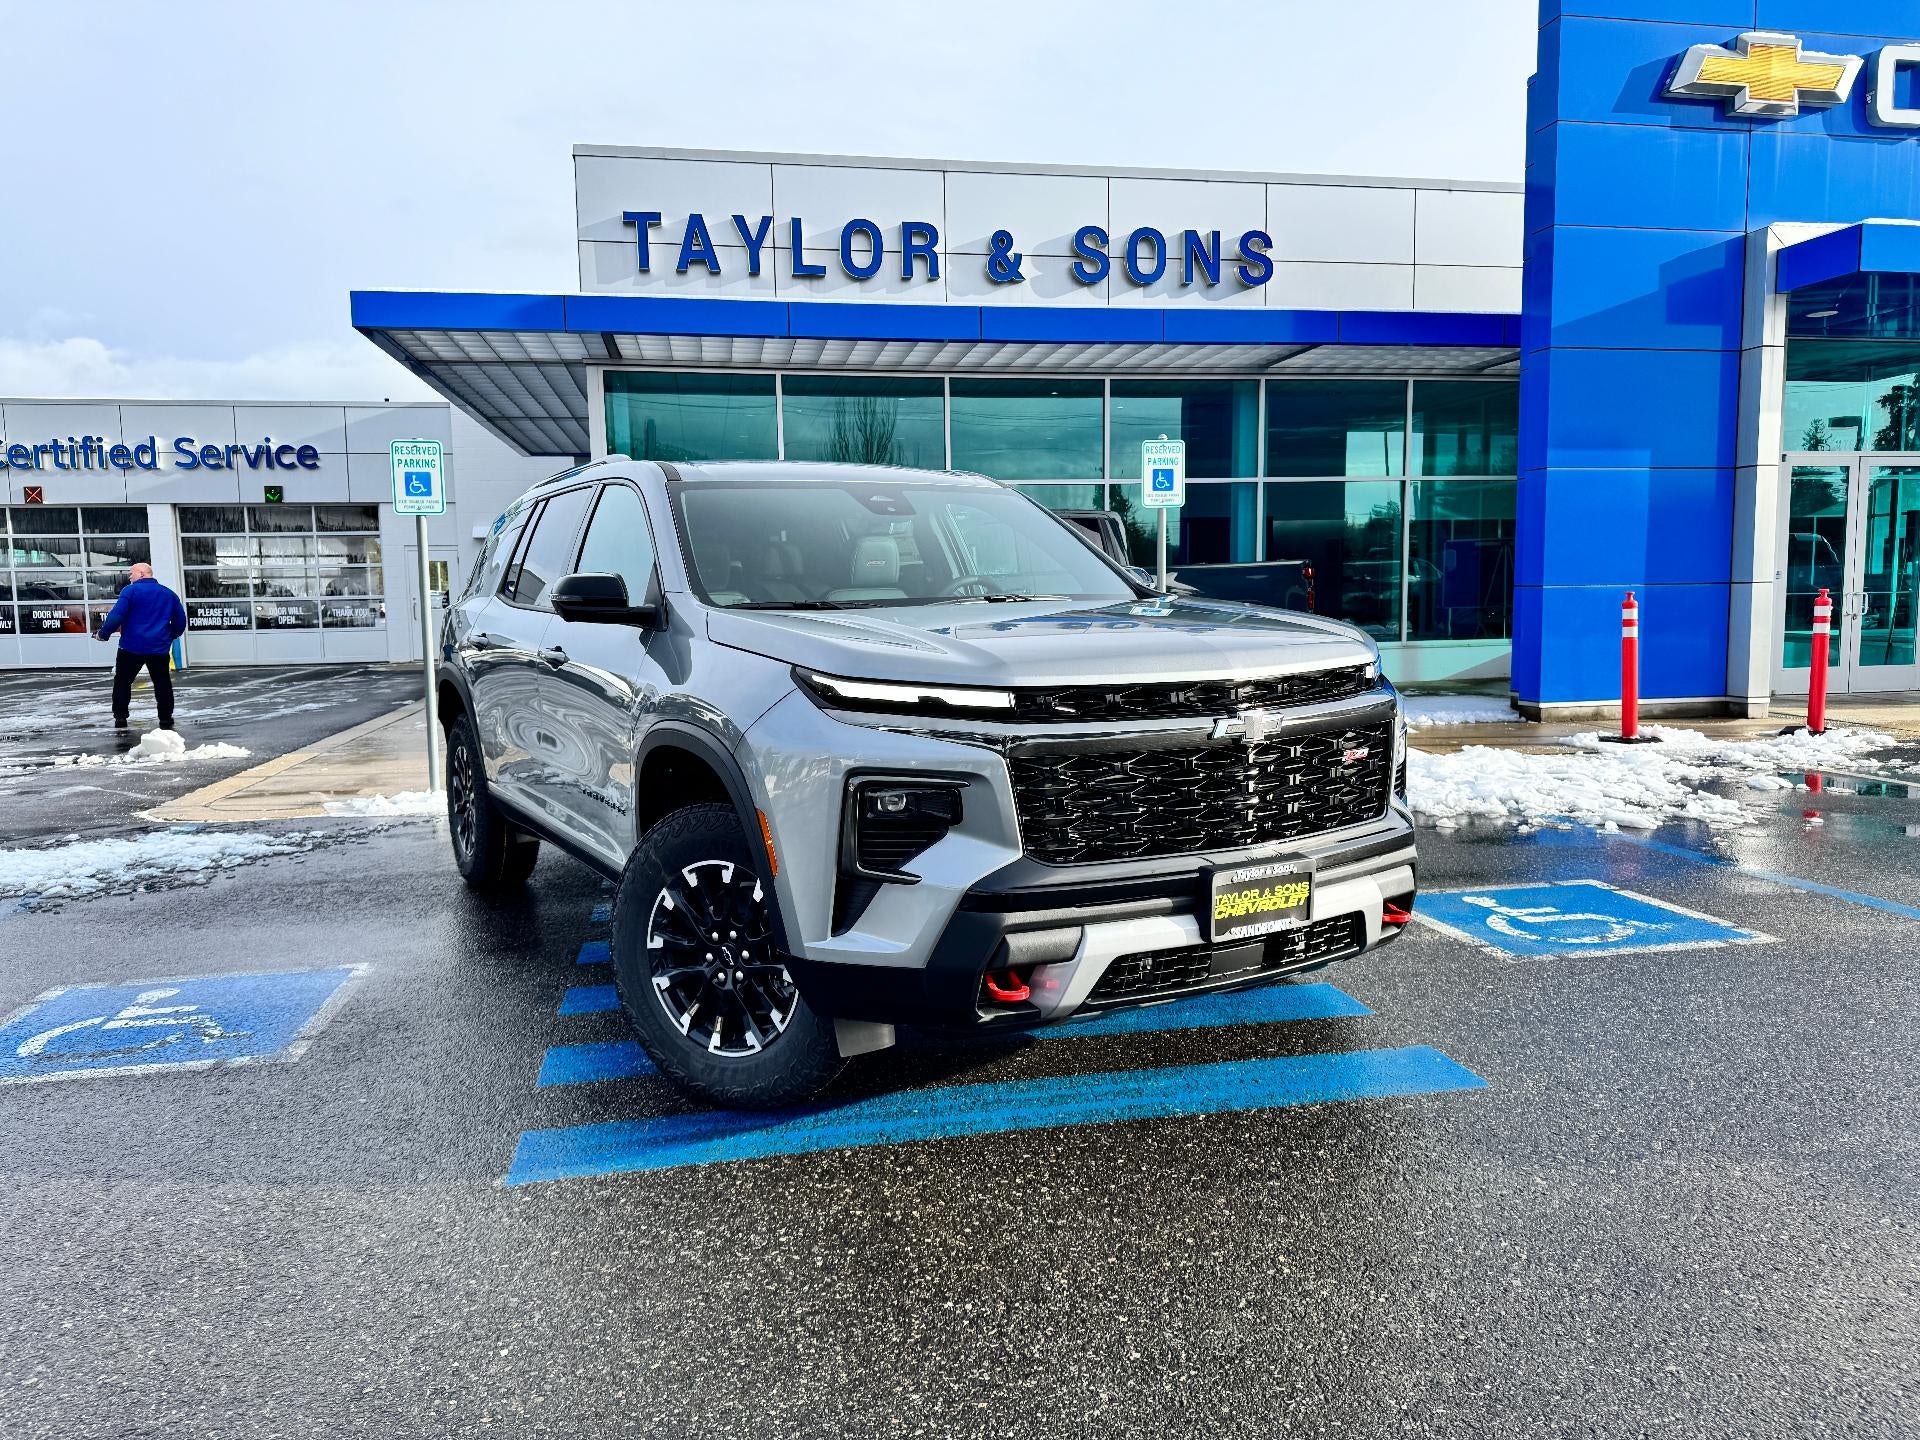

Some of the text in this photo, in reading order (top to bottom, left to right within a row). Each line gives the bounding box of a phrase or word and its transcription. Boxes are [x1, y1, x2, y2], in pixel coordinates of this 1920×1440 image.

[622, 210, 1274, 287] TAYLOR & SONS
[0, 435, 320, 470] ertified Service
[394, 445, 438, 456] RESERVED
[1145, 445, 1181, 455] RESERVED
[397, 458, 436, 469] PARKING
[1147, 457, 1179, 466] PARKING
[32, 610, 70, 619] DOOR WILL
[197, 607, 241, 617] PLEASE PULL
[268, 606, 304, 616] DOOR WILL
[332, 608, 353, 617] THANK
[42, 619, 61, 629] OPEN
[189, 616, 249, 627] FORWARD SLOWLY
[278, 615, 296, 625] OPEN
[1215, 881, 1310, 907] TAYLOR & SONS
[1214, 892, 1310, 920] CHEVROLET
